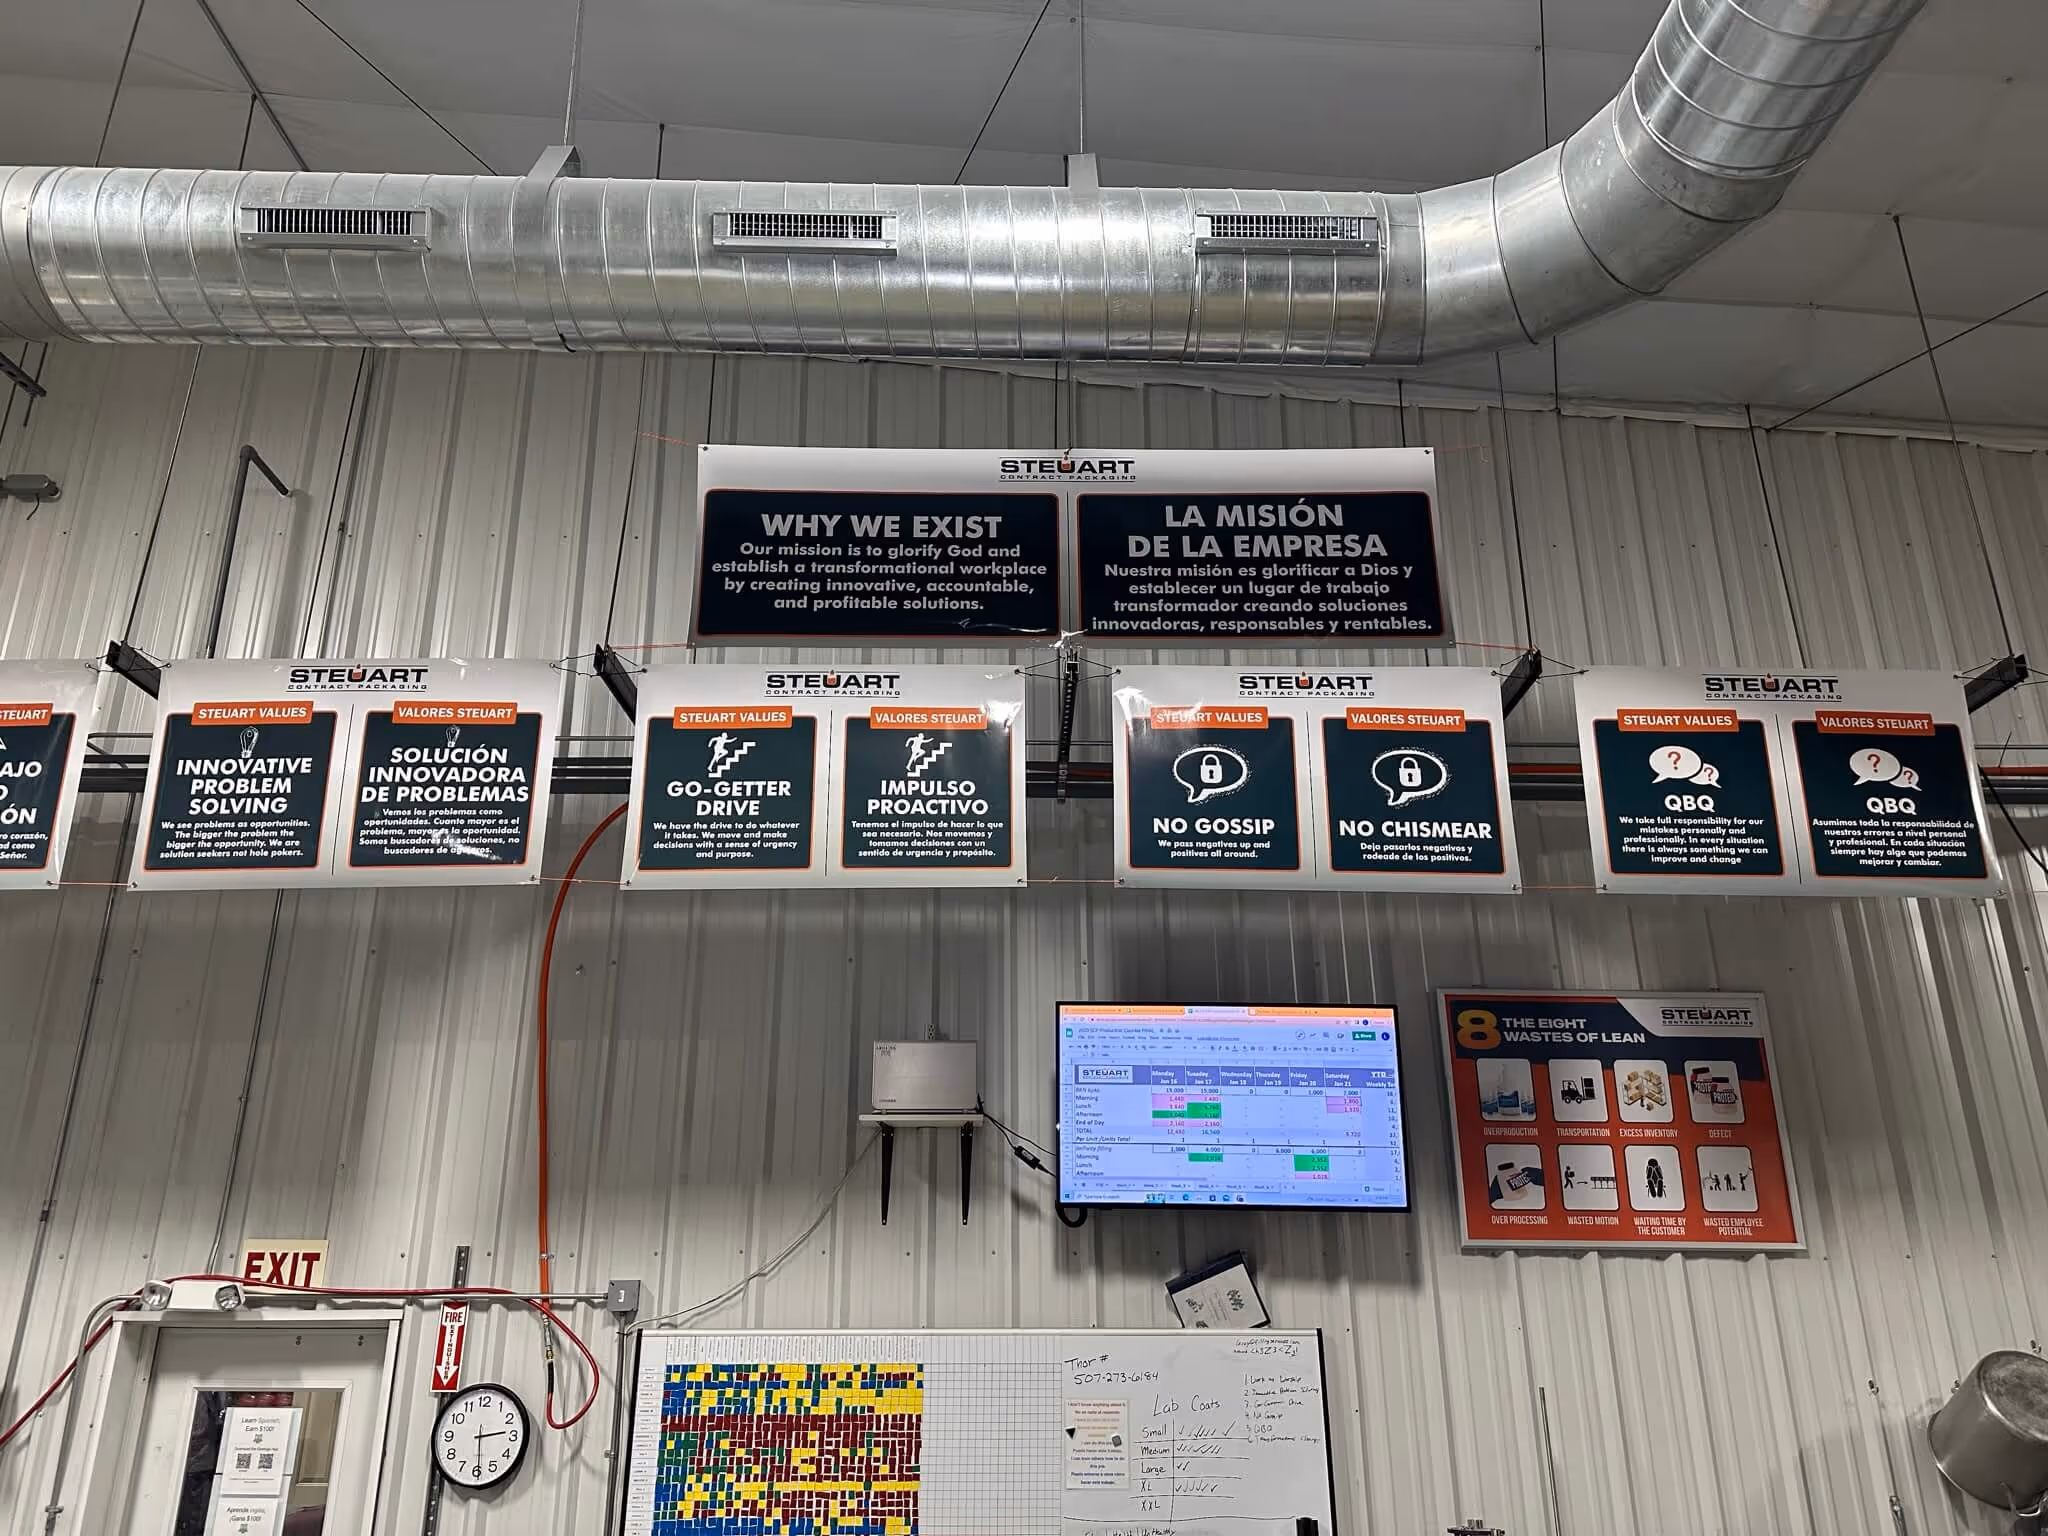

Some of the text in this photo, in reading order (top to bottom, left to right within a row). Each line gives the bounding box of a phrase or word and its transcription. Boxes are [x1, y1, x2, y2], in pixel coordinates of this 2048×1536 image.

[1000, 460, 1135, 474] STEUART
[1166, 498, 1343, 527] LA MISIÓN
[762, 514, 1002, 538] WHY WE EXIST
[740, 543, 1020, 560] Our mission is to glorify God and
[1128, 534, 1388, 557] DE LA EMPRESA
[712, 560, 1046, 577] establish a transformational workplace
[725, 577, 1034, 594] by creating innovative, accountable,
[774, 596, 983, 611] and profitable solutions.
[290, 668, 428, 682] STEUART
[766, 674, 900, 688] STEUART
[1240, 676, 1373, 690] STEUART
[1704, 678, 1838, 692] STEUART
[198, 708, 306, 718] STEUART VALUES
[399, 707, 512, 718] VALORES STEUART
[680, 712, 786, 722] STEUART VALUES
[876, 713, 983, 724] VALORES STEUART
[1156, 712, 1262, 724] STEUART VALUES
[1351, 714, 1460, 725] VALORES STEUART
[1624, 716, 1732, 725] STEUART VALUES
[1821, 717, 1928, 729] VALORES STEUART
[390, 744, 507, 763] SOLUCIÓN
[177, 757, 312, 775] INNOVATIVE
[369, 767, 525, 782] INNOVADORA
[191, 778, 291, 794] PROBLEM
[668, 781, 790, 796] GO-GETTER
[882, 780, 975, 796] IMPULSO
[361, 786, 528, 802] DE PROBLEMAS
[189, 797, 287, 814] SOLVING
[697, 800, 760, 816] DRIVE
[868, 799, 988, 814] PROACTIVO
[1665, 795, 1715, 812] QBQ
[1867, 797, 1916, 815] QBQ
[1154, 818, 1274, 834] NO GOSSIP
[1340, 820, 1492, 838] NO CHISMEAR
[1174, 842, 1193, 850] pass
[1196, 840, 1237, 850] negatives
[1253, 841, 1270, 851] and
[1171, 850, 1208, 858] positives
[1224, 849, 1258, 858] around.
[1661, 1010, 1751, 1020] STEUART
[1502, 1018, 1586, 1028] THE EIGHT
[1457, 1010, 1501, 1050] 8
[1504, 1032, 1645, 1043] WASTES OF LEAN
[1484, 1128, 1538, 1136] OVERPRODUCTION
[1557, 1128, 1610, 1136] TRANSPORTATION
[1620, 1128, 1677, 1137] EXCESS INVENTORY
[1709, 1129, 1731, 1138] DEFECT
[1492, 1216, 1548, 1224] OVER PROCESSING
[1568, 1216, 1619, 1225] WASTED MOTION
[1634, 1217, 1686, 1227] WAITING TIME BY
[1704, 1217, 1764, 1227] WASTED EMPLOYEE
[1638, 1225, 1685, 1235] THE CUSTOMER
[1719, 1226, 1752, 1236] POTENTIAL
[243, 1252, 320, 1288] EXIT
[445, 1312, 463, 1322] FIRE
[444, 1324, 455, 1379] EXTINGUISHER
[1065, 1358, 1096, 1370] Thor
[1074, 1372, 1158, 1384] 507-273-6184
[464, 1401, 473, 1412] 11
[479, 1396, 492, 1407] 12
[499, 1401, 502, 1412] 1
[1153, 1394, 1220, 1416] Lab Coats
[452, 1413, 465, 1424] 10
[505, 1413, 514, 1424] 2
[444, 1430, 454, 1442] 9
[509, 1430, 518, 1442] 3
[1142, 1424, 1166, 1438] Small
[447, 1448, 456, 1460] 8
[502, 1448, 510, 1459] 4
[1141, 1446, 1172, 1457] Medium
[459, 1461, 466, 1472] 7
[472, 1465, 481, 1477] 6
[488, 1461, 497, 1472] 5
[1142, 1462, 1166, 1476] Large
[1141, 1481, 1152, 1492] XL
[1142, 1500, 1160, 1511] XXL
